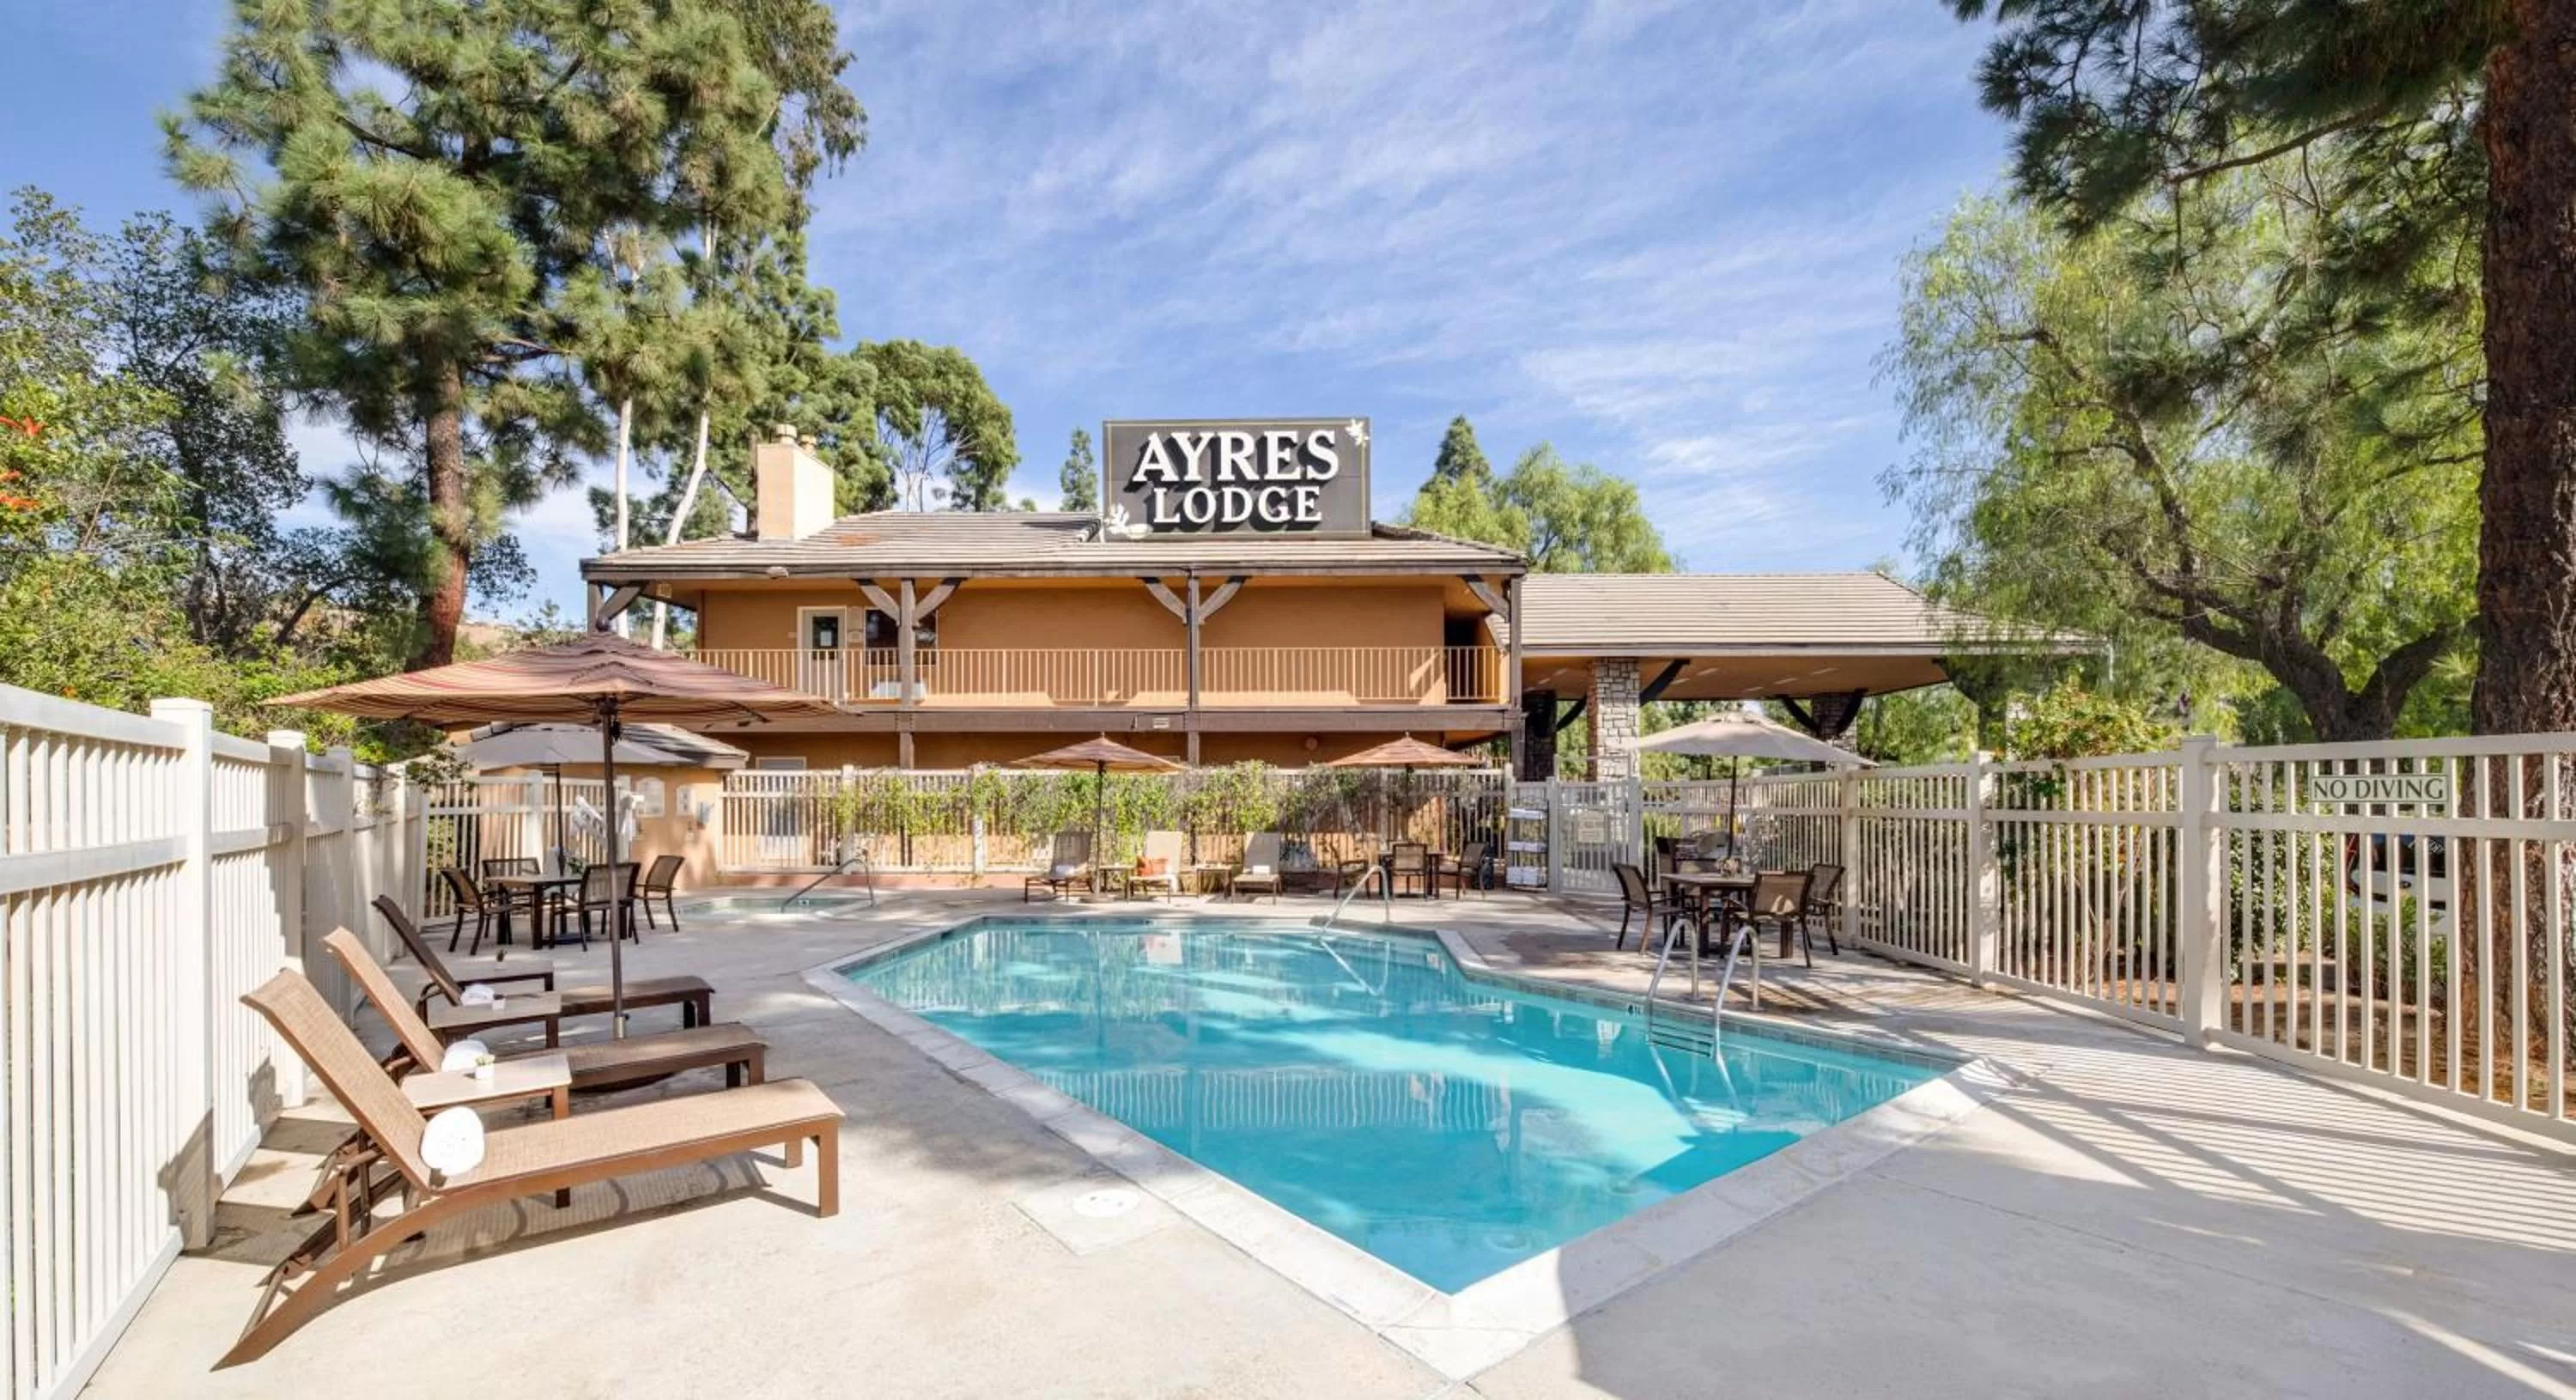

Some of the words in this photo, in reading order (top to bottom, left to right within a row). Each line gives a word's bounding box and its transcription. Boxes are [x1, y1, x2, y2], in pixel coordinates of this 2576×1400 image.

[1132, 429, 1340, 482] AYRES
[1153, 485, 1322, 523] LODGE
[2313, 779, 2347, 799] NO
[2355, 777, 2444, 800] DIVING
